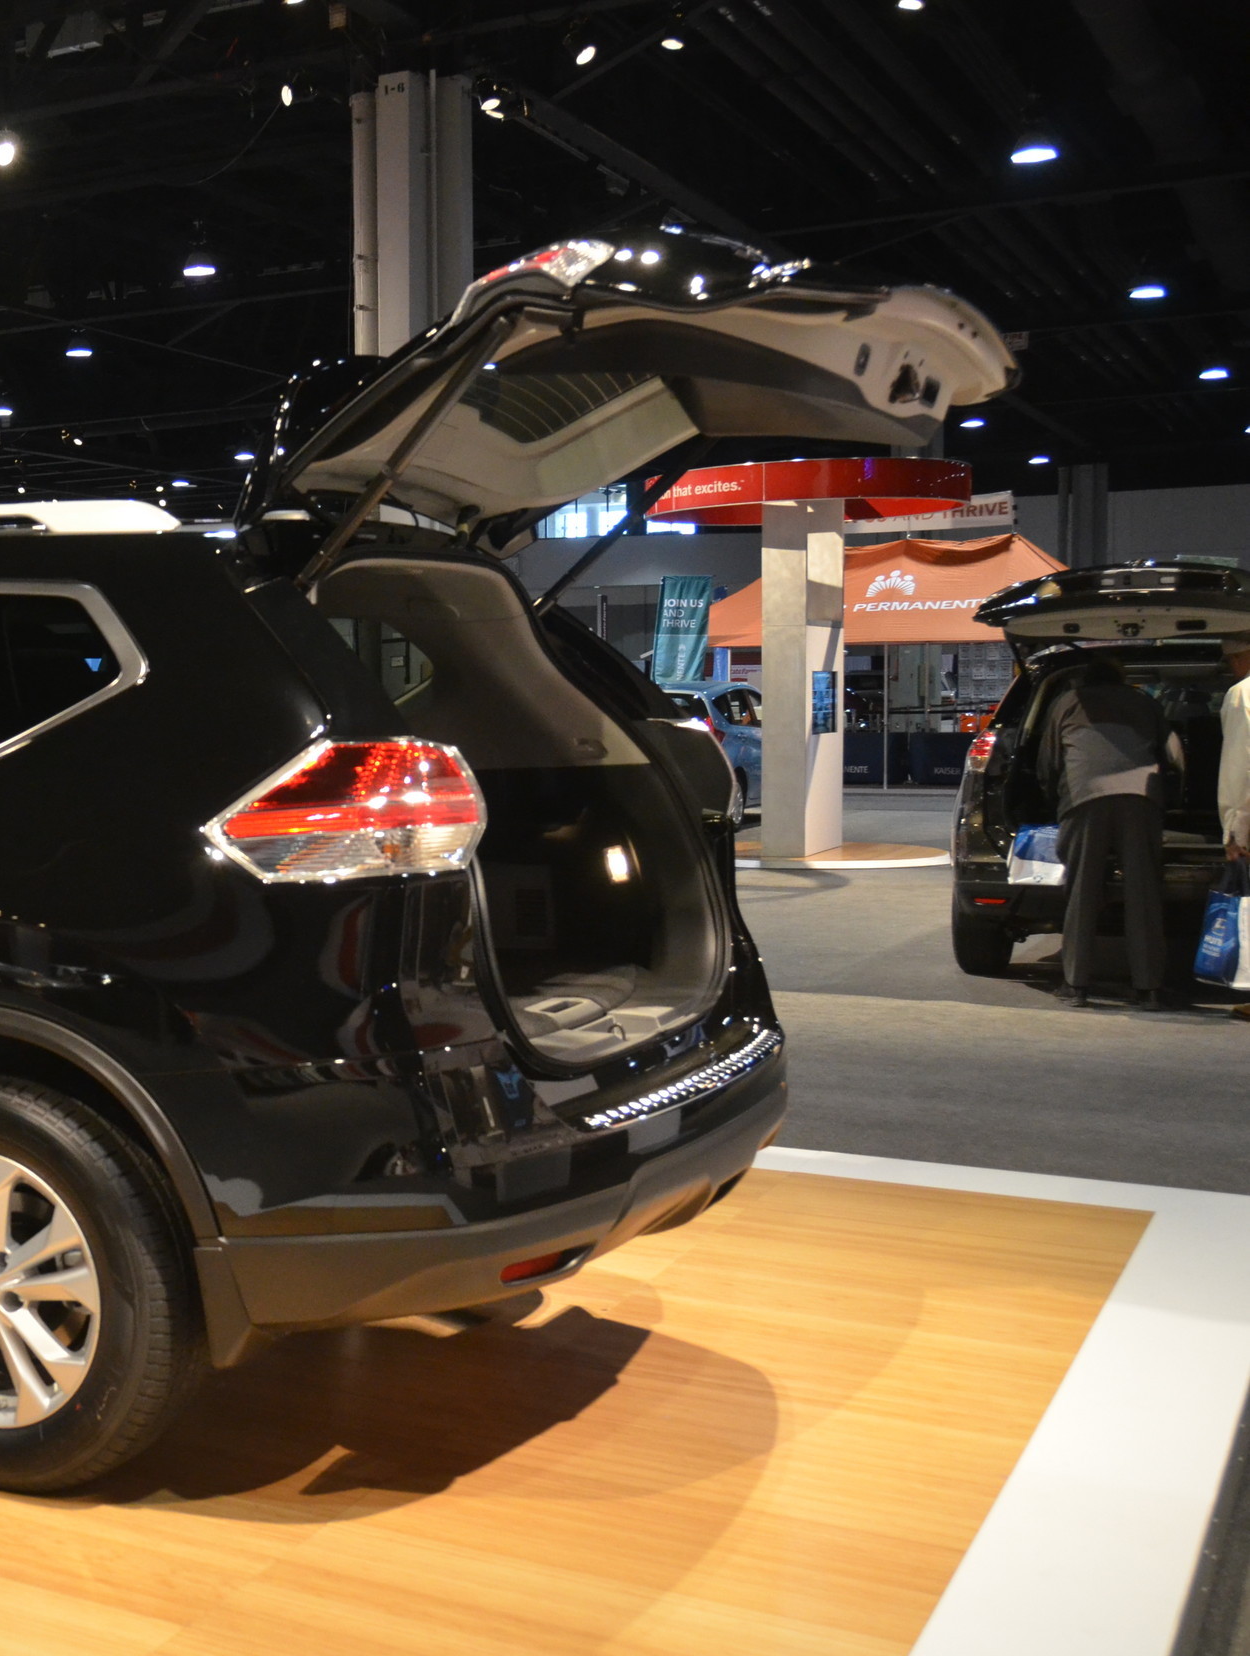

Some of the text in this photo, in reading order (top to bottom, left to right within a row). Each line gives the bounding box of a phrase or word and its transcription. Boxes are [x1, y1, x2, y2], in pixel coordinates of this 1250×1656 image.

[672, 485, 692, 497] that
[663, 599, 704, 608] JOIN US
[853, 598, 985, 612] PERMANENT
[662, 608, 685, 618] AND
[662, 619, 697, 628] THRIVE
